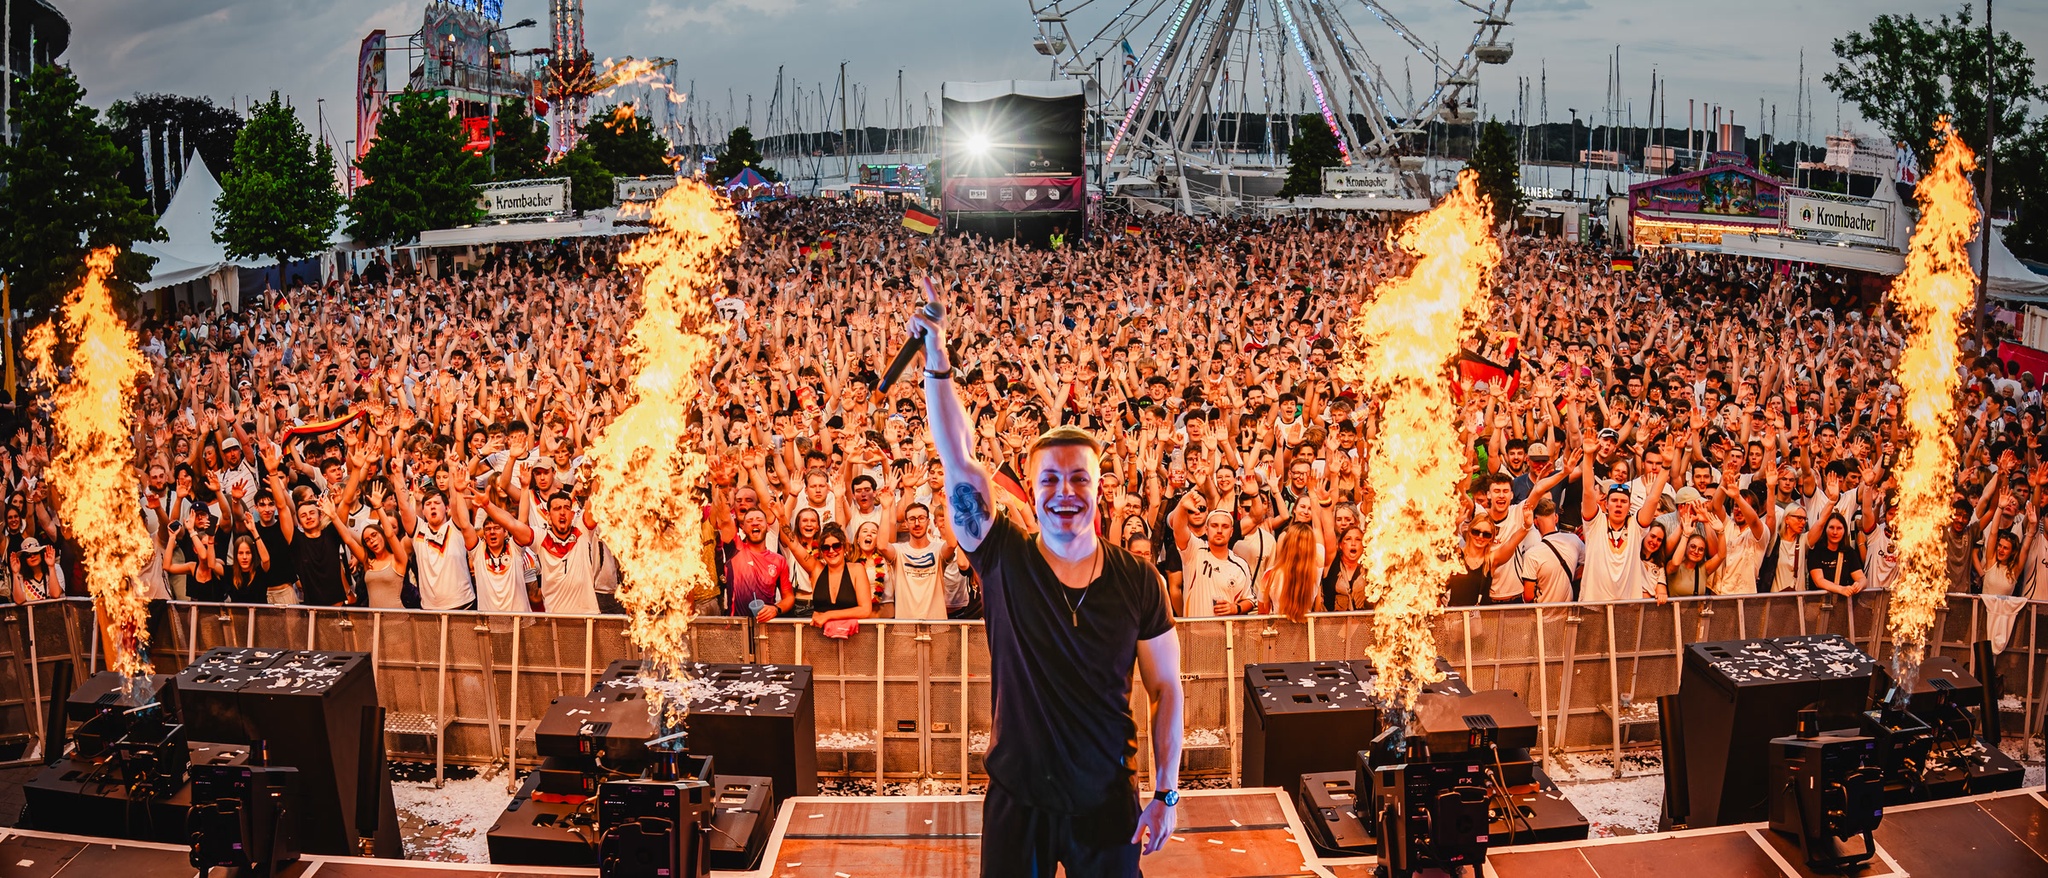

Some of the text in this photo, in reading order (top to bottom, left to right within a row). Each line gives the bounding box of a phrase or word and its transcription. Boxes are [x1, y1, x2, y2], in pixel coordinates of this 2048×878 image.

[496, 192, 553, 210] Krombacher
[1816, 206, 1877, 232] Krombacher
[720, 308, 738, 322] 17
